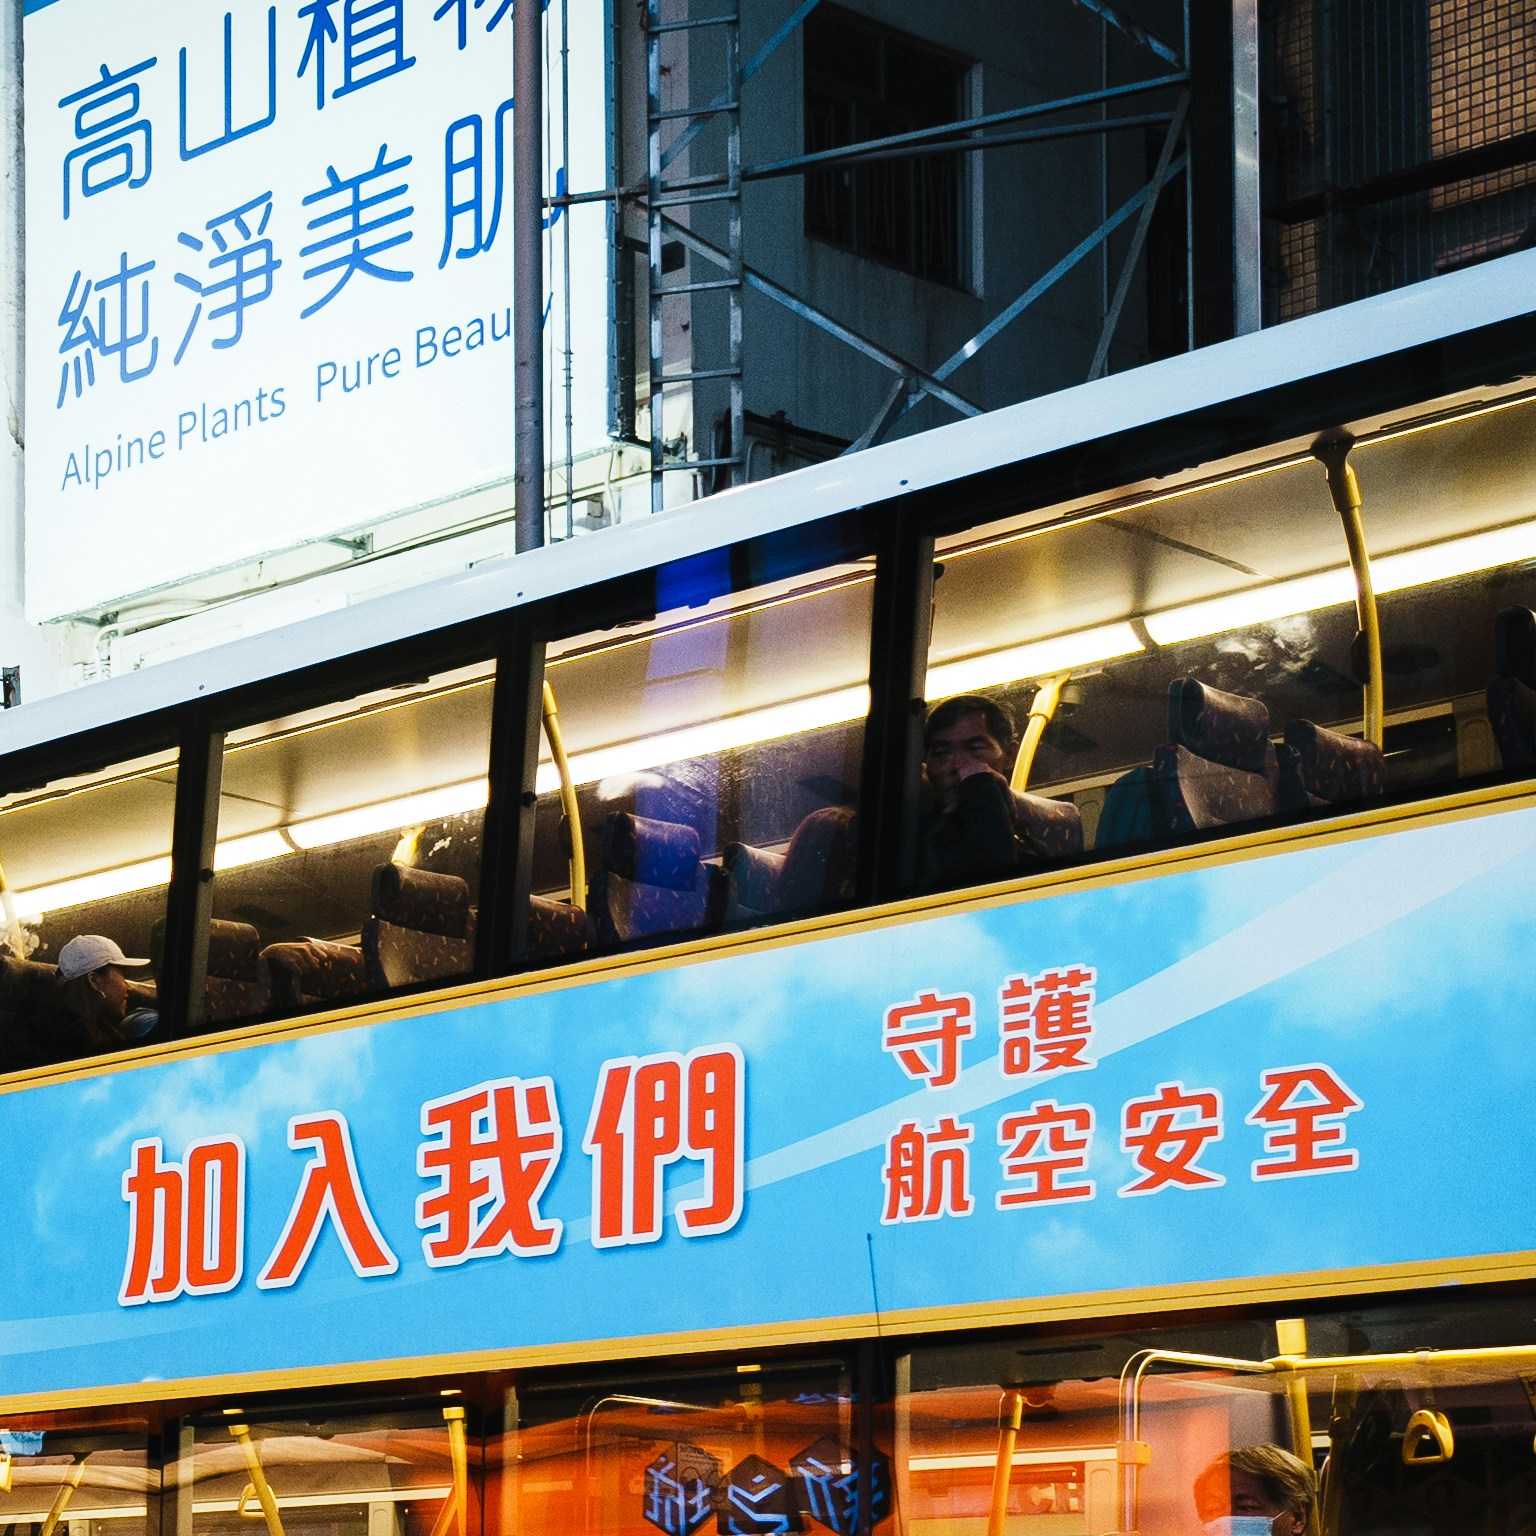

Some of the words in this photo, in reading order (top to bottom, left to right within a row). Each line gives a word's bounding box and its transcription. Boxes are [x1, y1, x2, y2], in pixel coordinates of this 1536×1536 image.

[58, 0, 550, 220] 高山植
[57, 98, 565, 409] 純淨美肌
[61, 425, 167, 491] Alpine
[178, 386, 287, 451] Plants
[316, 344, 401, 402] Pure
[415, 291, 554, 368] Beau
[887, 970, 1093, 1084] 守護
[127, 1054, 735, 1296] 加入我們
[887, 1066, 1358, 1219] 航空安全
